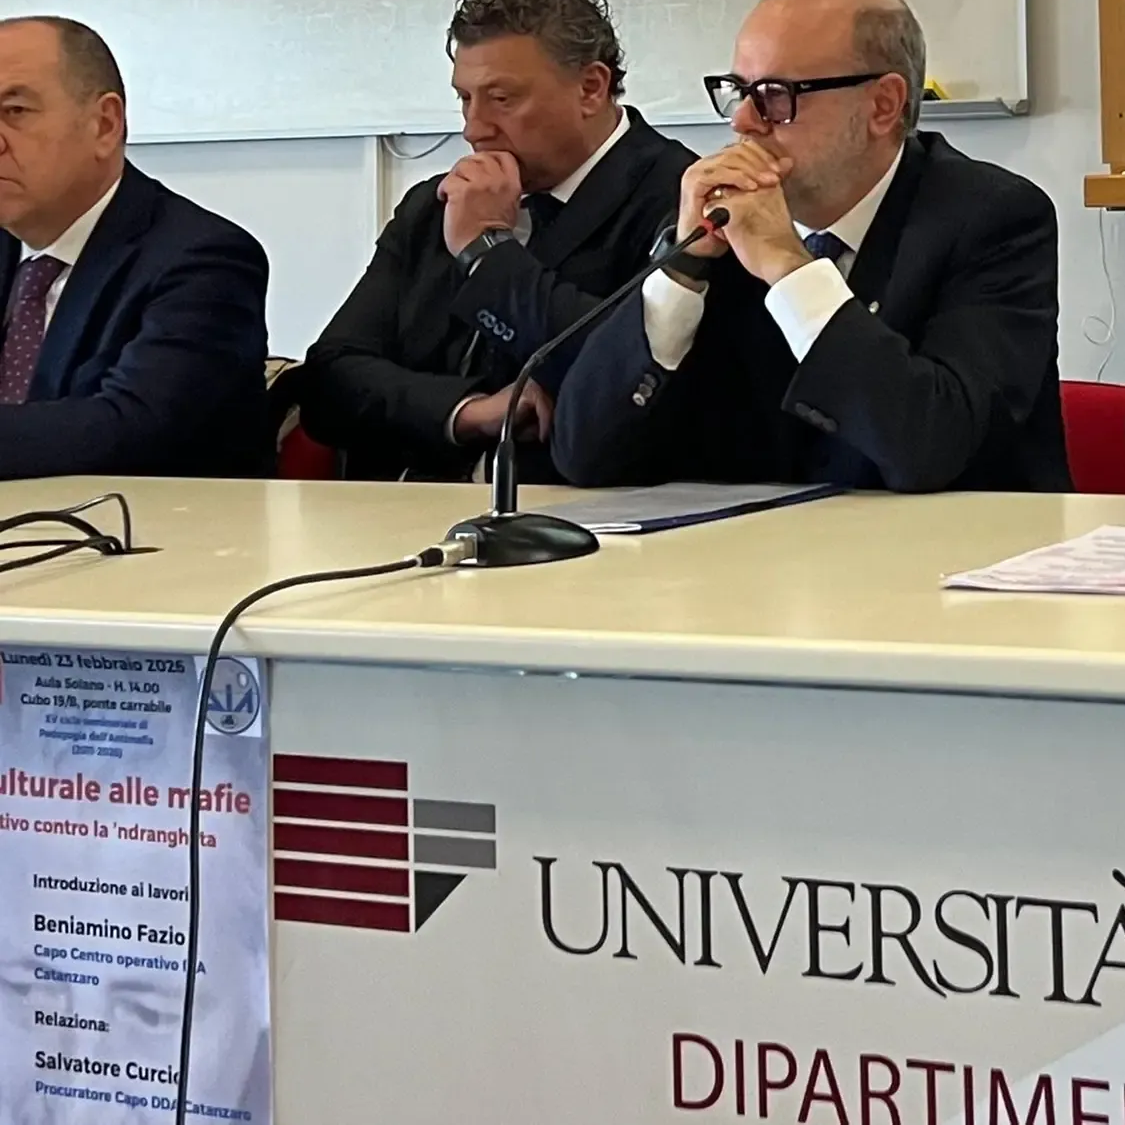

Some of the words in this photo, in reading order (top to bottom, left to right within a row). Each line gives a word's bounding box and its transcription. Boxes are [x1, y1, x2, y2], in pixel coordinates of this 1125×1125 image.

[55, 654, 73, 668] 23
[78, 654, 142, 672] febbraio
[35, 676, 61, 689] Aula
[65, 677, 104, 691] Solano
[114, 680, 126, 693] H.
[129, 681, 160, 694] 14.00
[20, 693, 50, 706] Cubo
[83, 698, 117, 712] ponte
[120, 699, 172, 713] carrabile
[109, 776, 159, 807] alle
[168, 782, 251, 815] mafie
[34, 819, 89, 837] contro
[94, 820, 108, 838] la
[113, 821, 216, 849] 'ndranghta
[33, 874, 127, 896] Introduzione
[131, 884, 144, 898] ai
[148, 882, 189, 902] lavori
[34, 914, 132, 941] Beniamino
[137, 924, 186, 946] Fazio
[34, 944, 67, 962] Capo
[70, 947, 113, 964] Centro
[116, 953, 179, 972] operativo
[34, 967, 99, 986] Catanzaro
[35, 1050, 121, 1078] Salvatore
[35, 1080, 112, 1103] Procuratore
[115, 1090, 148, 1110] Capo
